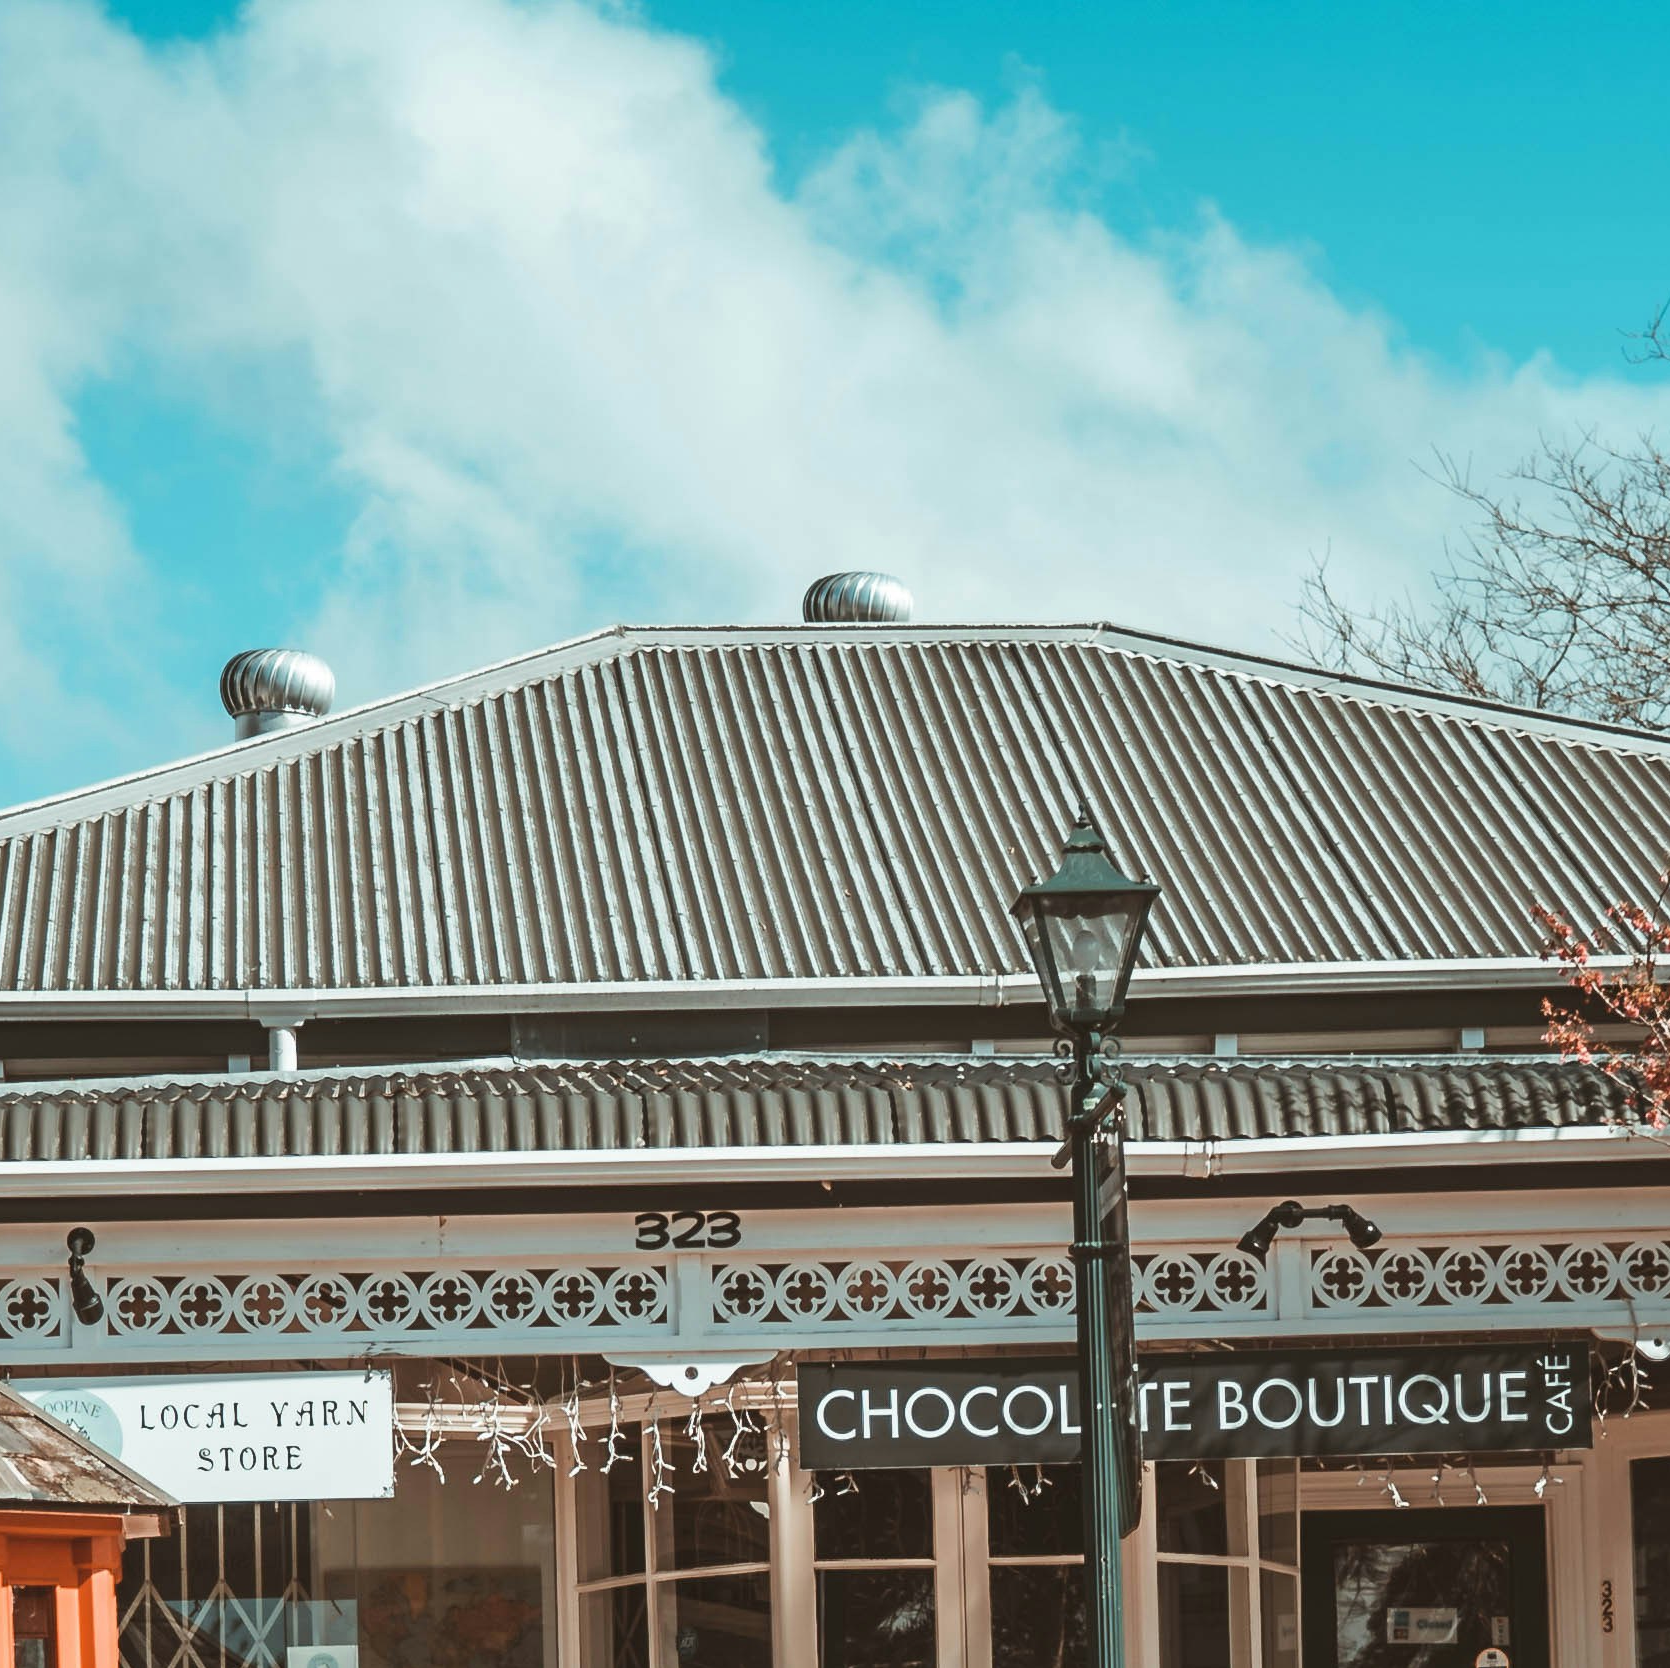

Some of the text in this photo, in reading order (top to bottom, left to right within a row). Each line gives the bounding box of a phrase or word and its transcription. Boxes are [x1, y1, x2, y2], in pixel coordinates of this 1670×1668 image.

[634, 1211, 742, 1249] 323
[42, 1398, 102, 1418] OOPINE
[816, 1370, 1530, 1441] CHOCOLTE BOUTIQUE
[1536, 1354, 1573, 1435] CAFÉ
[139, 1399, 370, 1430] LOCAL YARN
[197, 1445, 304, 1472] STORE
[1601, 1580, 1614, 1633] 323
